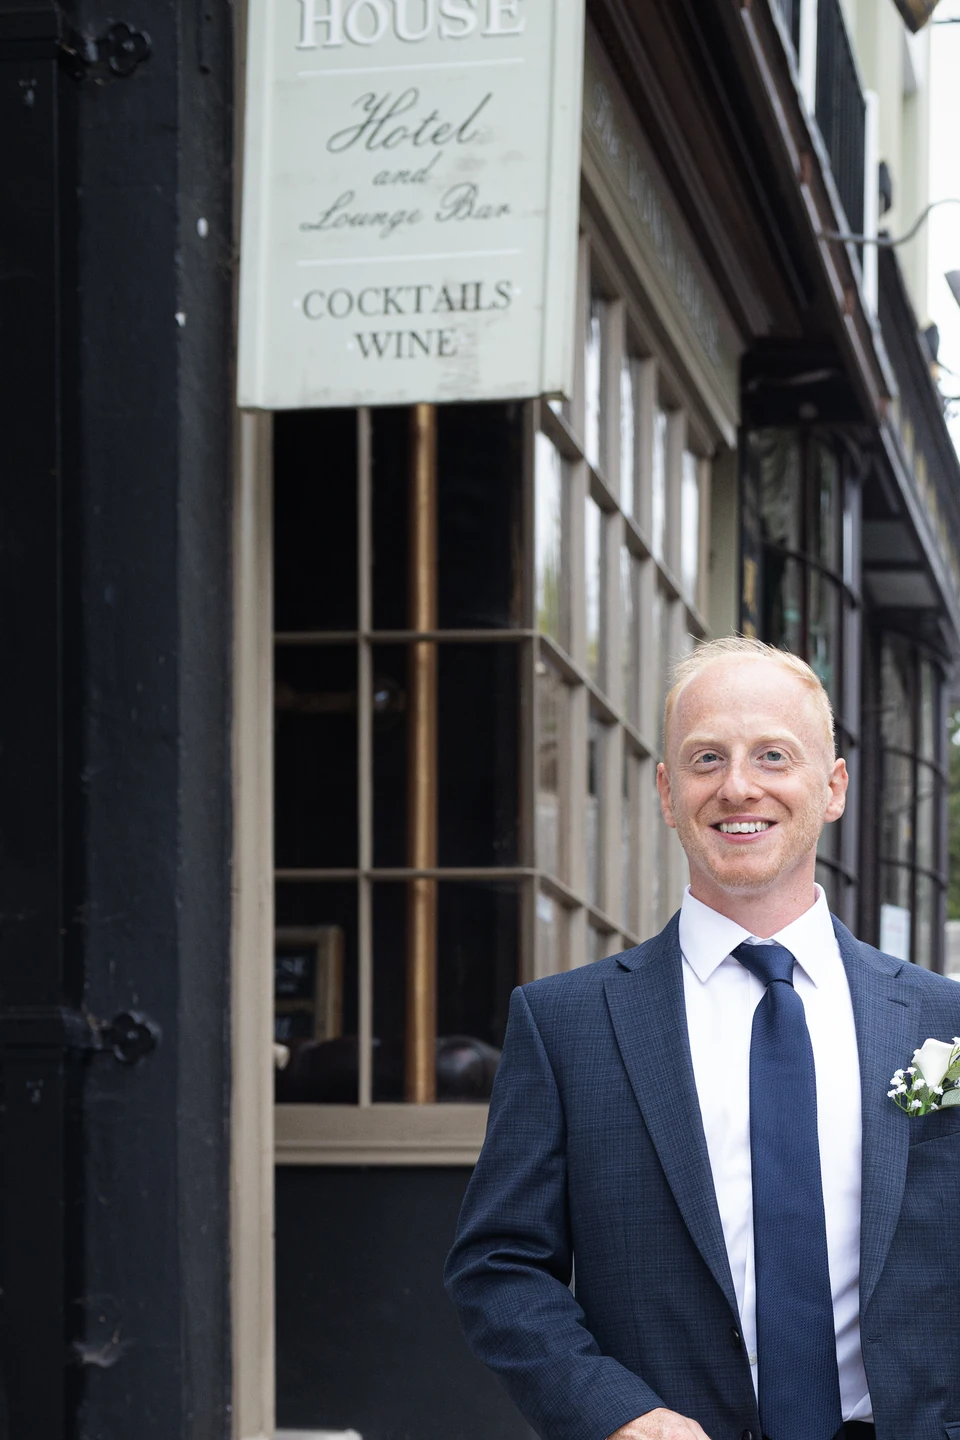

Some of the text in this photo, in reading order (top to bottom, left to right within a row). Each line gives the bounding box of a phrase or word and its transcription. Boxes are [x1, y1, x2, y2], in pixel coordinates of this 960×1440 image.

[295, 0, 526, 50] HOUSE
[326, 87, 493, 154] Hotel
[372, 150, 443, 186] and
[299, 182, 511, 239] Lounge Bar
[302, 280, 513, 320] COCKTAILS
[354, 328, 458, 361] WINE
